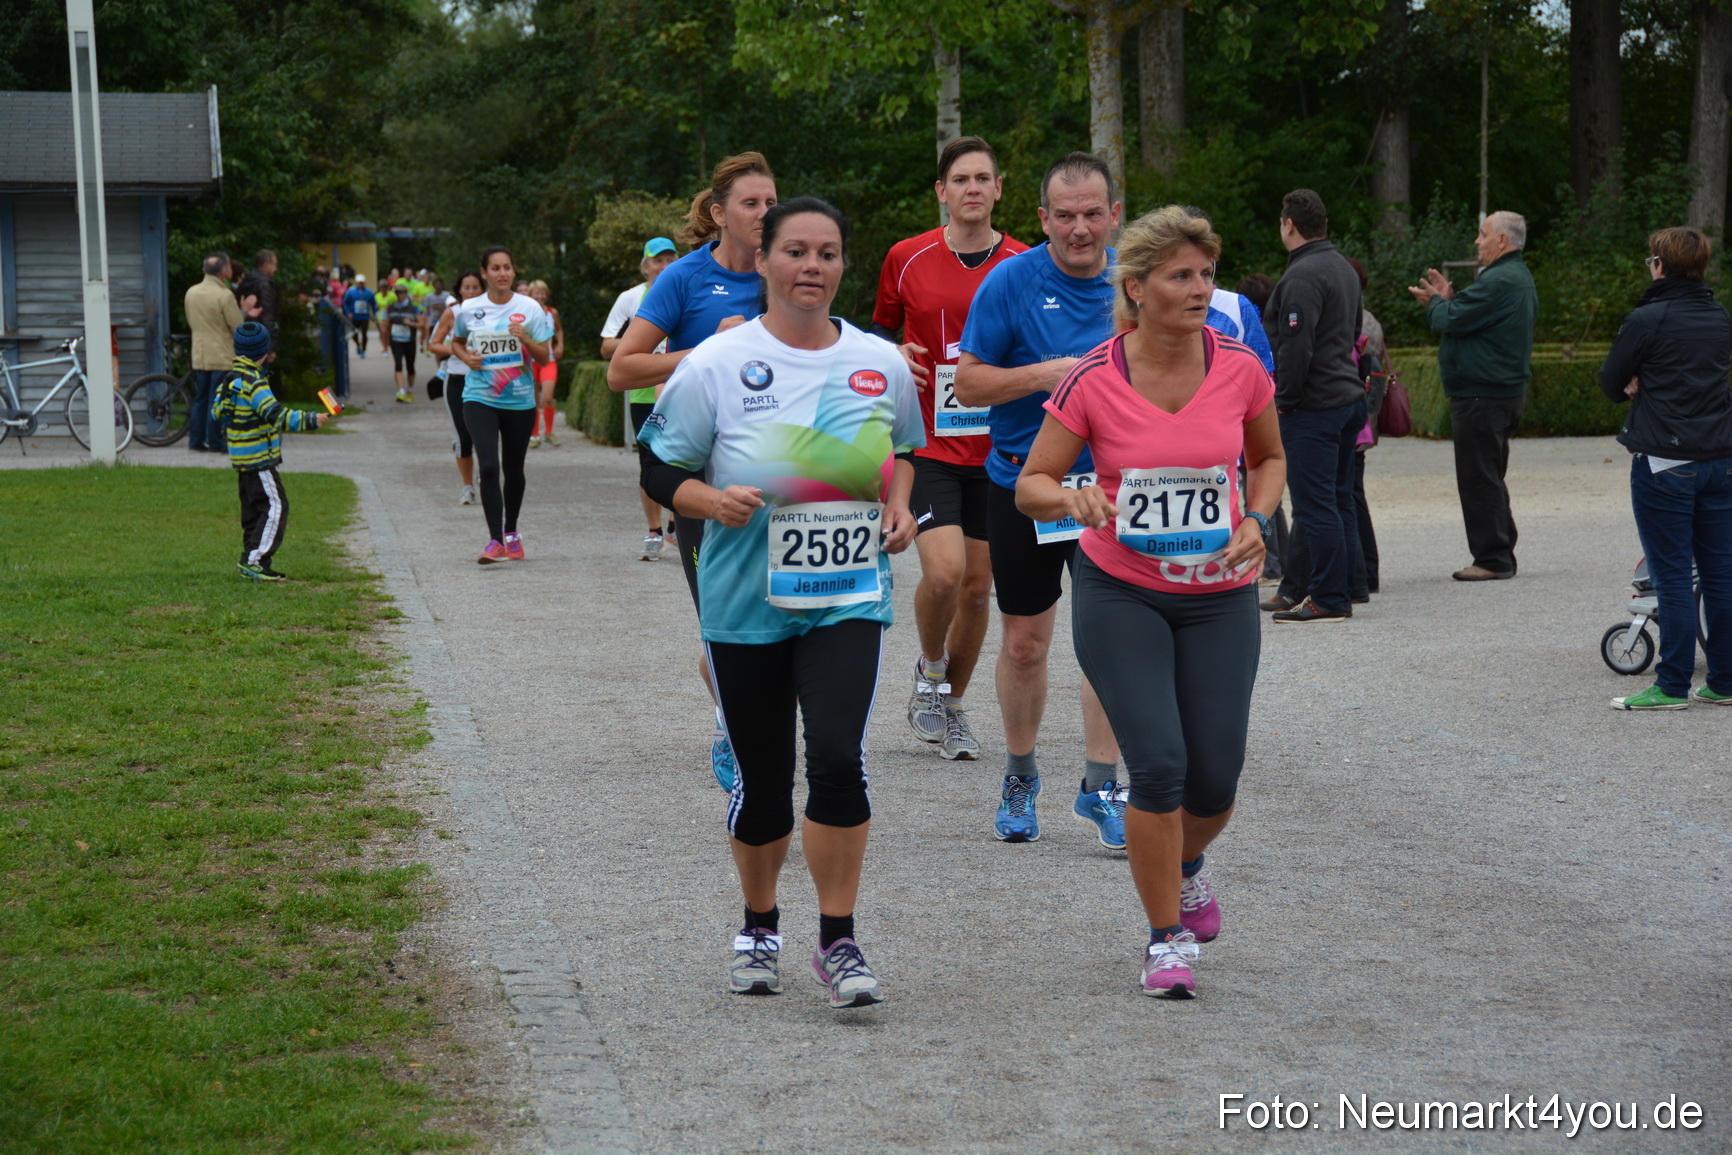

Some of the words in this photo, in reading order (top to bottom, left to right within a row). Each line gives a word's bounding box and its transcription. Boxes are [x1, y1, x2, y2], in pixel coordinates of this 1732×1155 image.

[480, 339, 518, 355] 2078
[854, 375, 884, 390] Hervis
[743, 394, 779, 406] PARTL
[744, 403, 780, 413] Neumarkt
[1122, 477, 1156, 488] PARTL
[1158, 476, 1212, 485] Neumarkt
[1128, 488, 1220, 529] 2178
[772, 513, 811, 523] PARTL
[813, 511, 864, 523] Neumarkt
[781, 526, 871, 568] 2582
[1147, 536, 1203, 553] Daniela
[793, 577, 856, 593] Jeannine
